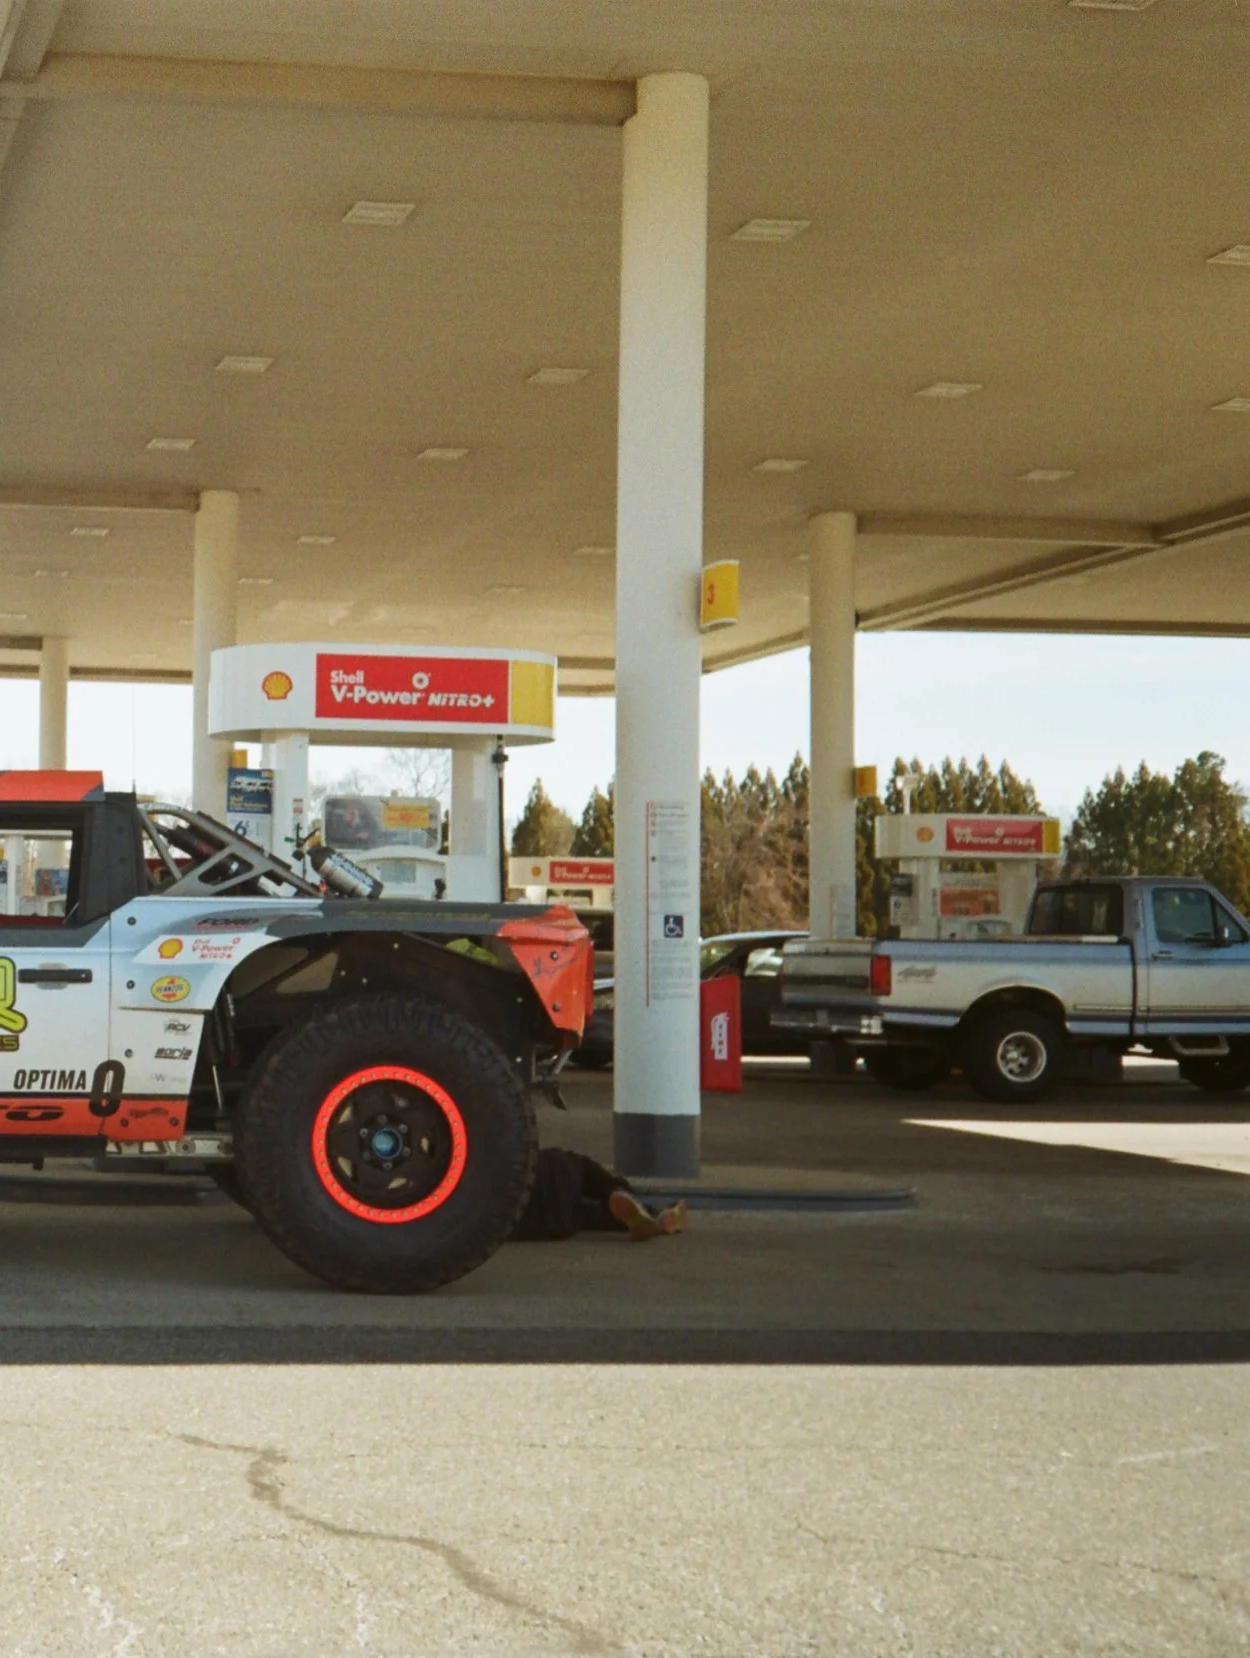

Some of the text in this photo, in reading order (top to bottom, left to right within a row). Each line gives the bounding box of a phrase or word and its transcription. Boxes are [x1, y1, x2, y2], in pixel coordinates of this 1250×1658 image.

[330, 670, 364, 684] Shell
[331, 684, 495, 708] V-Power NITRO+
[13, 1069, 87, 1090] OPTIMA
